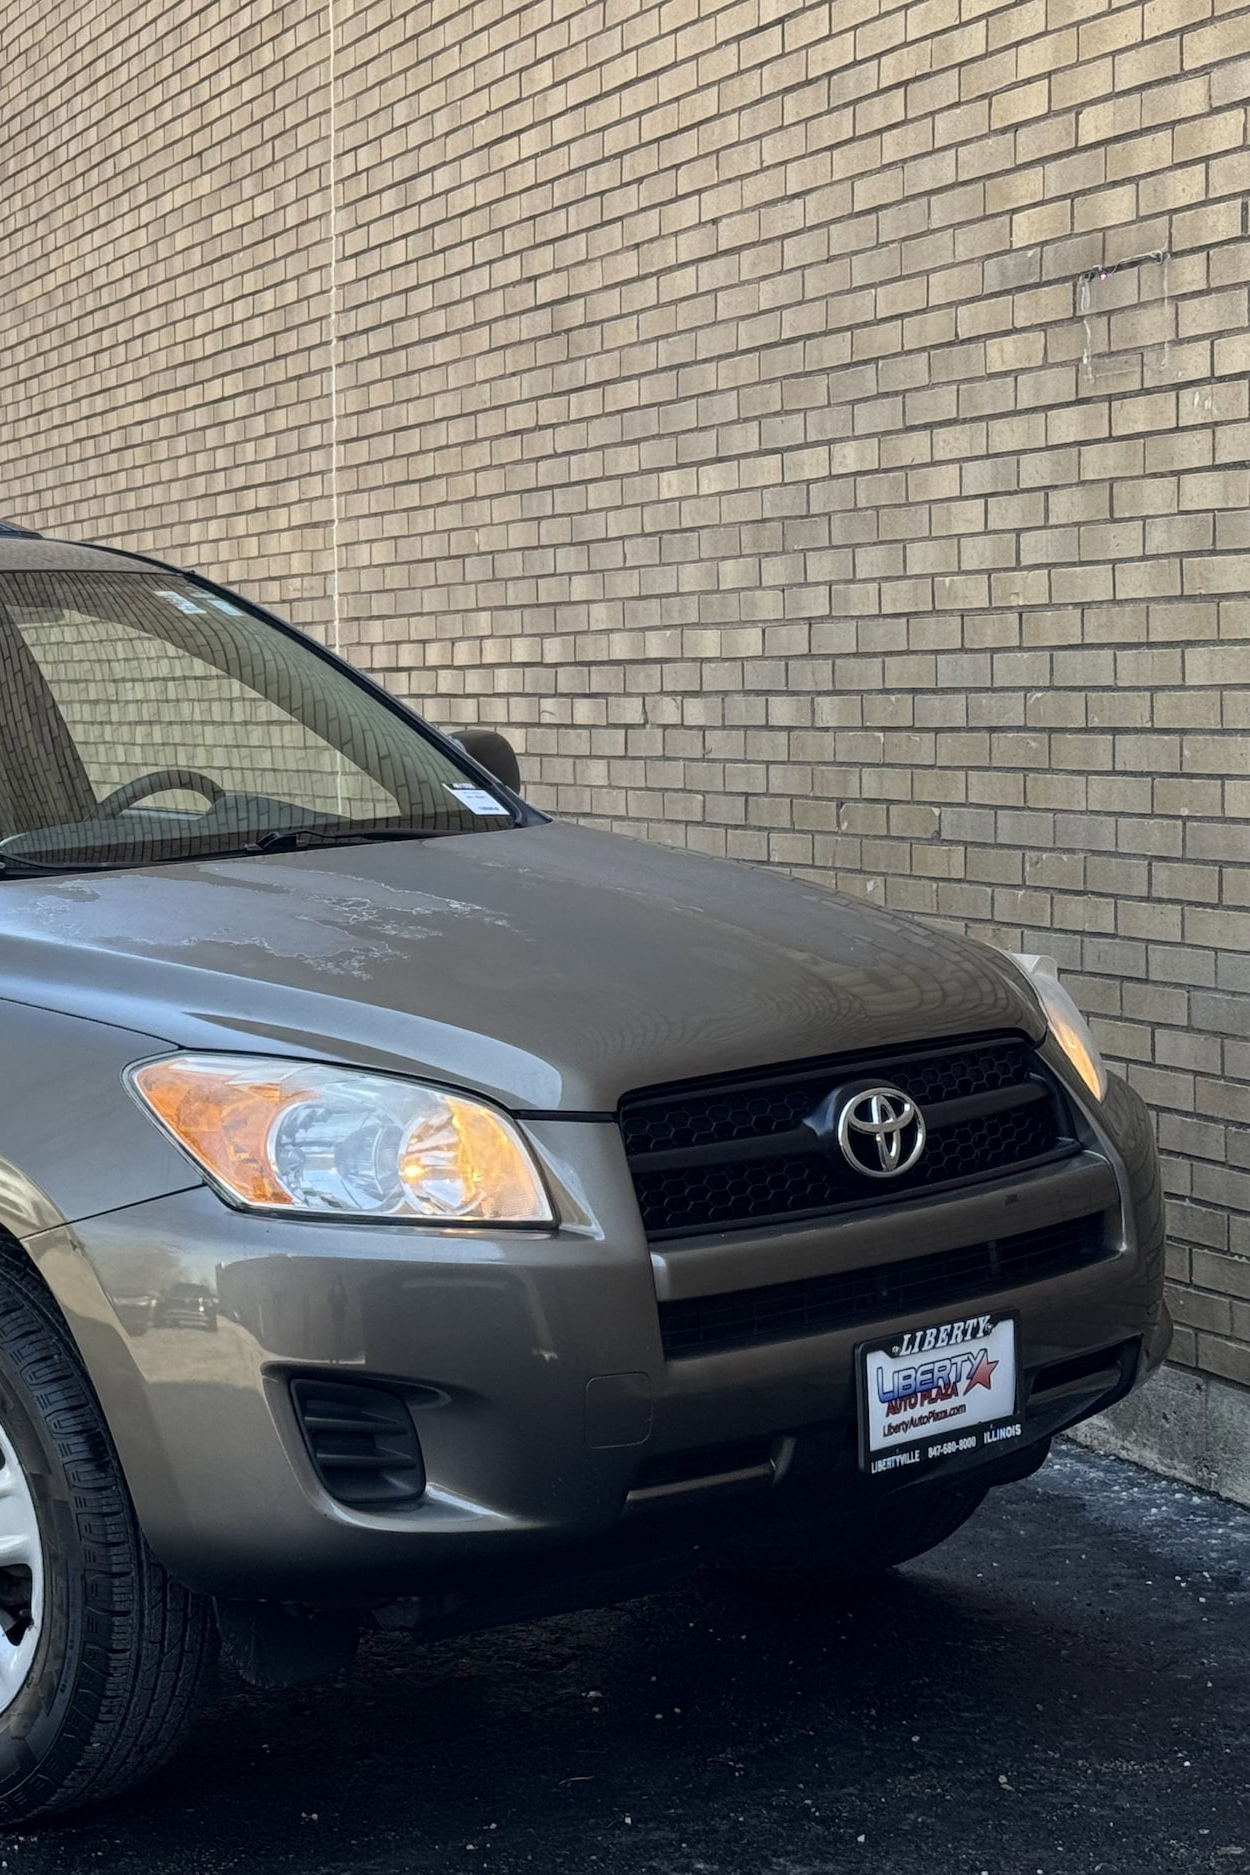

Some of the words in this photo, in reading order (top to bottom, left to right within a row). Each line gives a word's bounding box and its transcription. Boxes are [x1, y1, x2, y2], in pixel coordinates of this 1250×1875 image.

[900, 1315, 992, 1356] LIBERTY
[885, 1394, 919, 1417] AUTO
[920, 1382, 959, 1407] PLAZA
[871, 1449, 921, 1474] LIBERTYVILLE
[983, 1423, 1022, 1444] ILLINOIS
